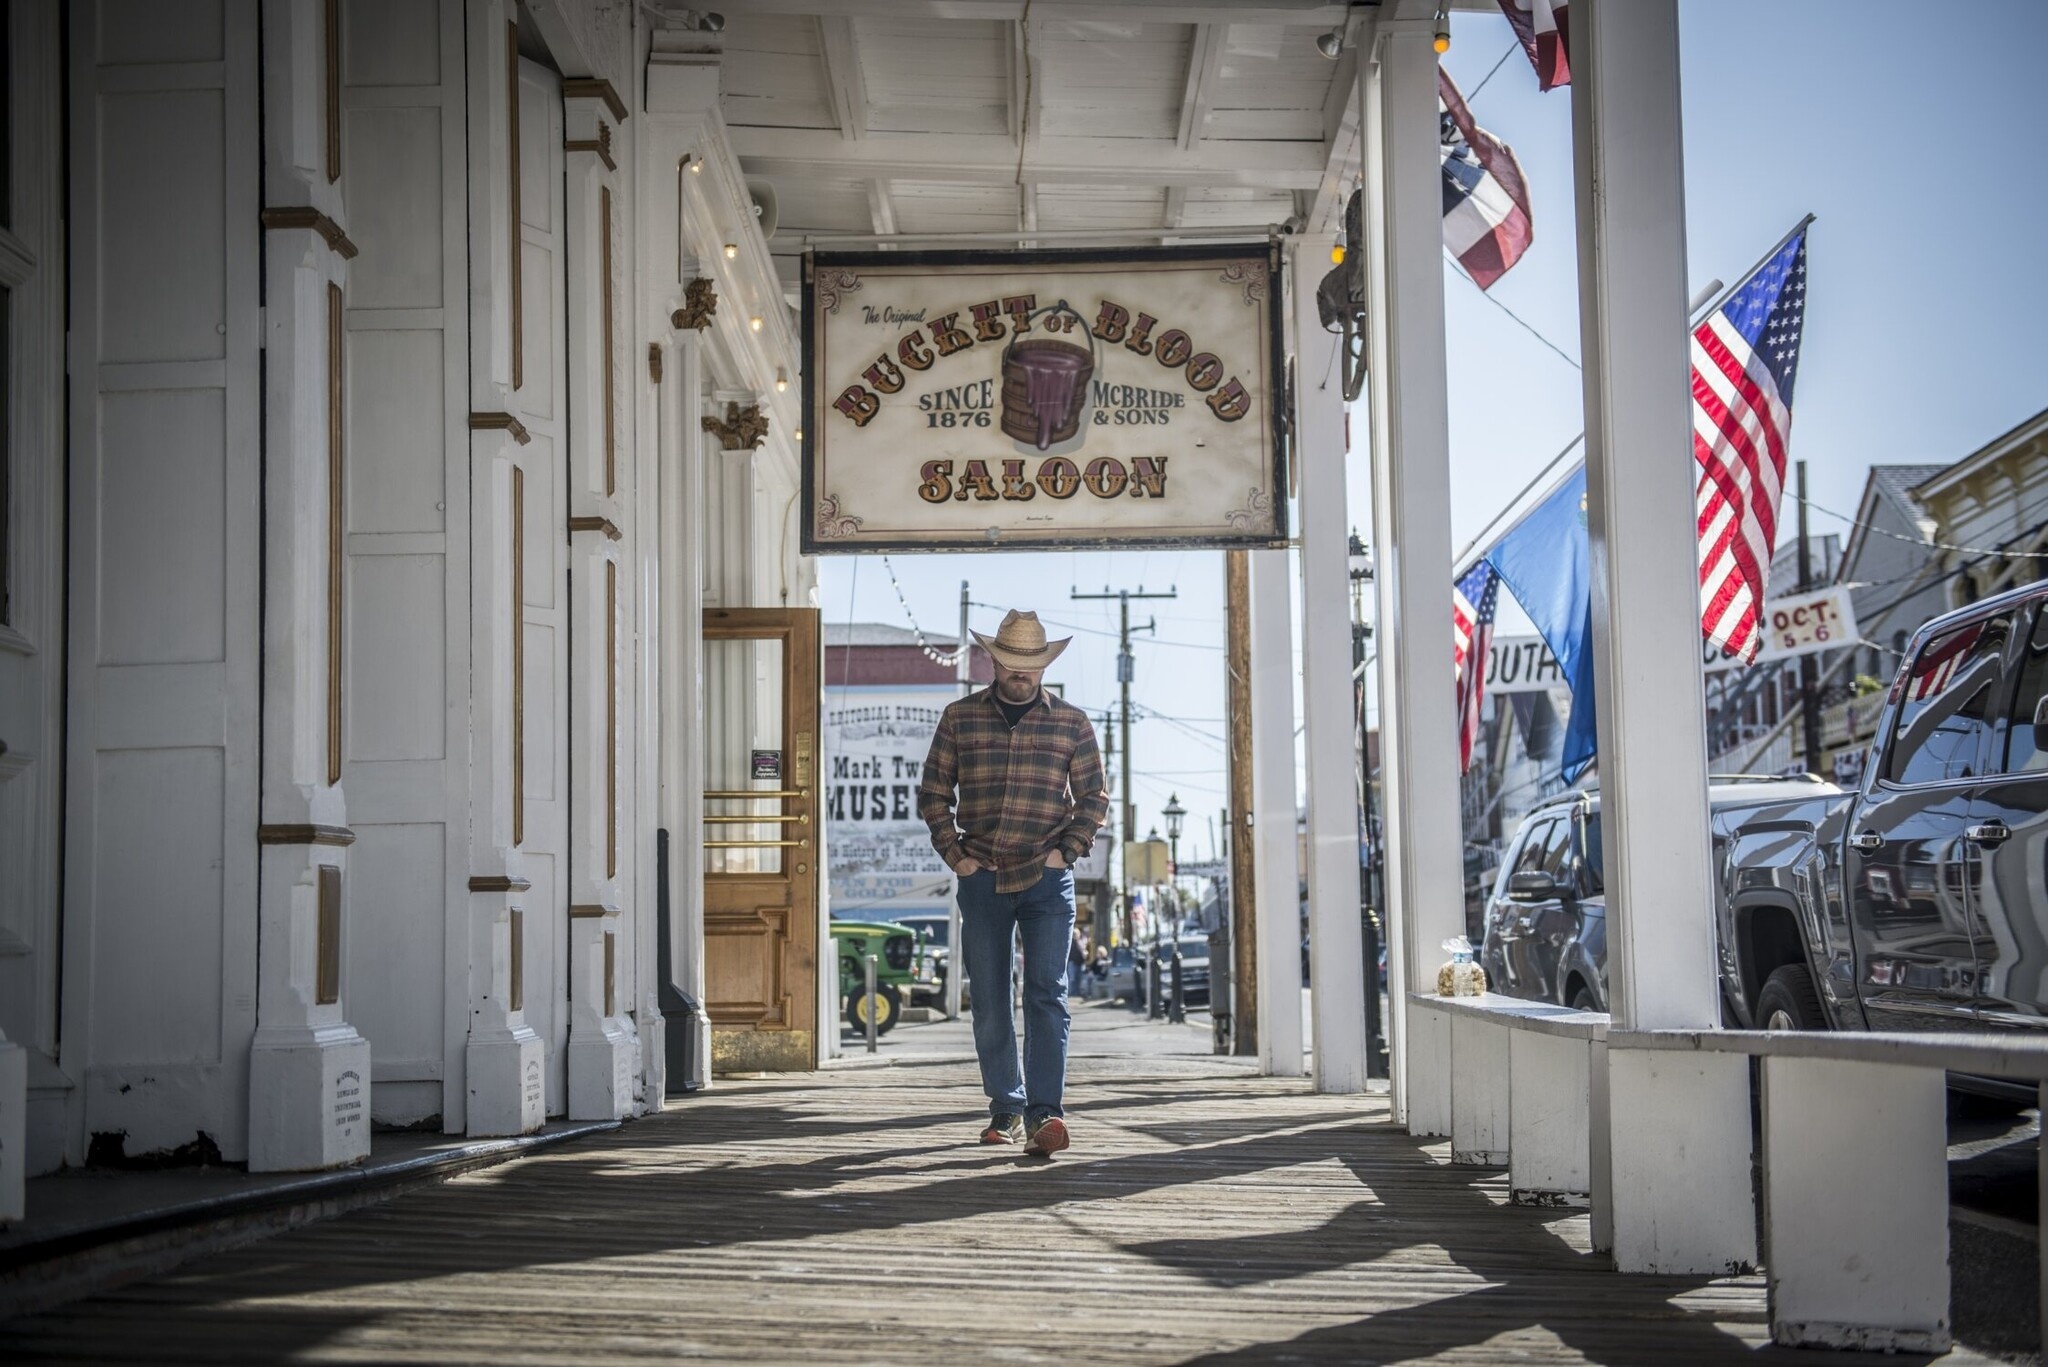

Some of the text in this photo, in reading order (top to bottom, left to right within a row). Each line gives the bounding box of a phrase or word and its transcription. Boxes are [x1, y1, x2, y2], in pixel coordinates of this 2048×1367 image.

[862, 305, 927, 330] The Original
[832, 294, 1251, 427] BUCKET OF BLOOD
[919, 378, 994, 411] SINCE
[927, 411, 991, 428] 1876
[1093, 409, 1170, 425] & SONS
[918, 456, 1168, 503] SALOON
[1773, 601, 1837, 631] OCT.
[834, 755, 927, 778] Mark Tw
